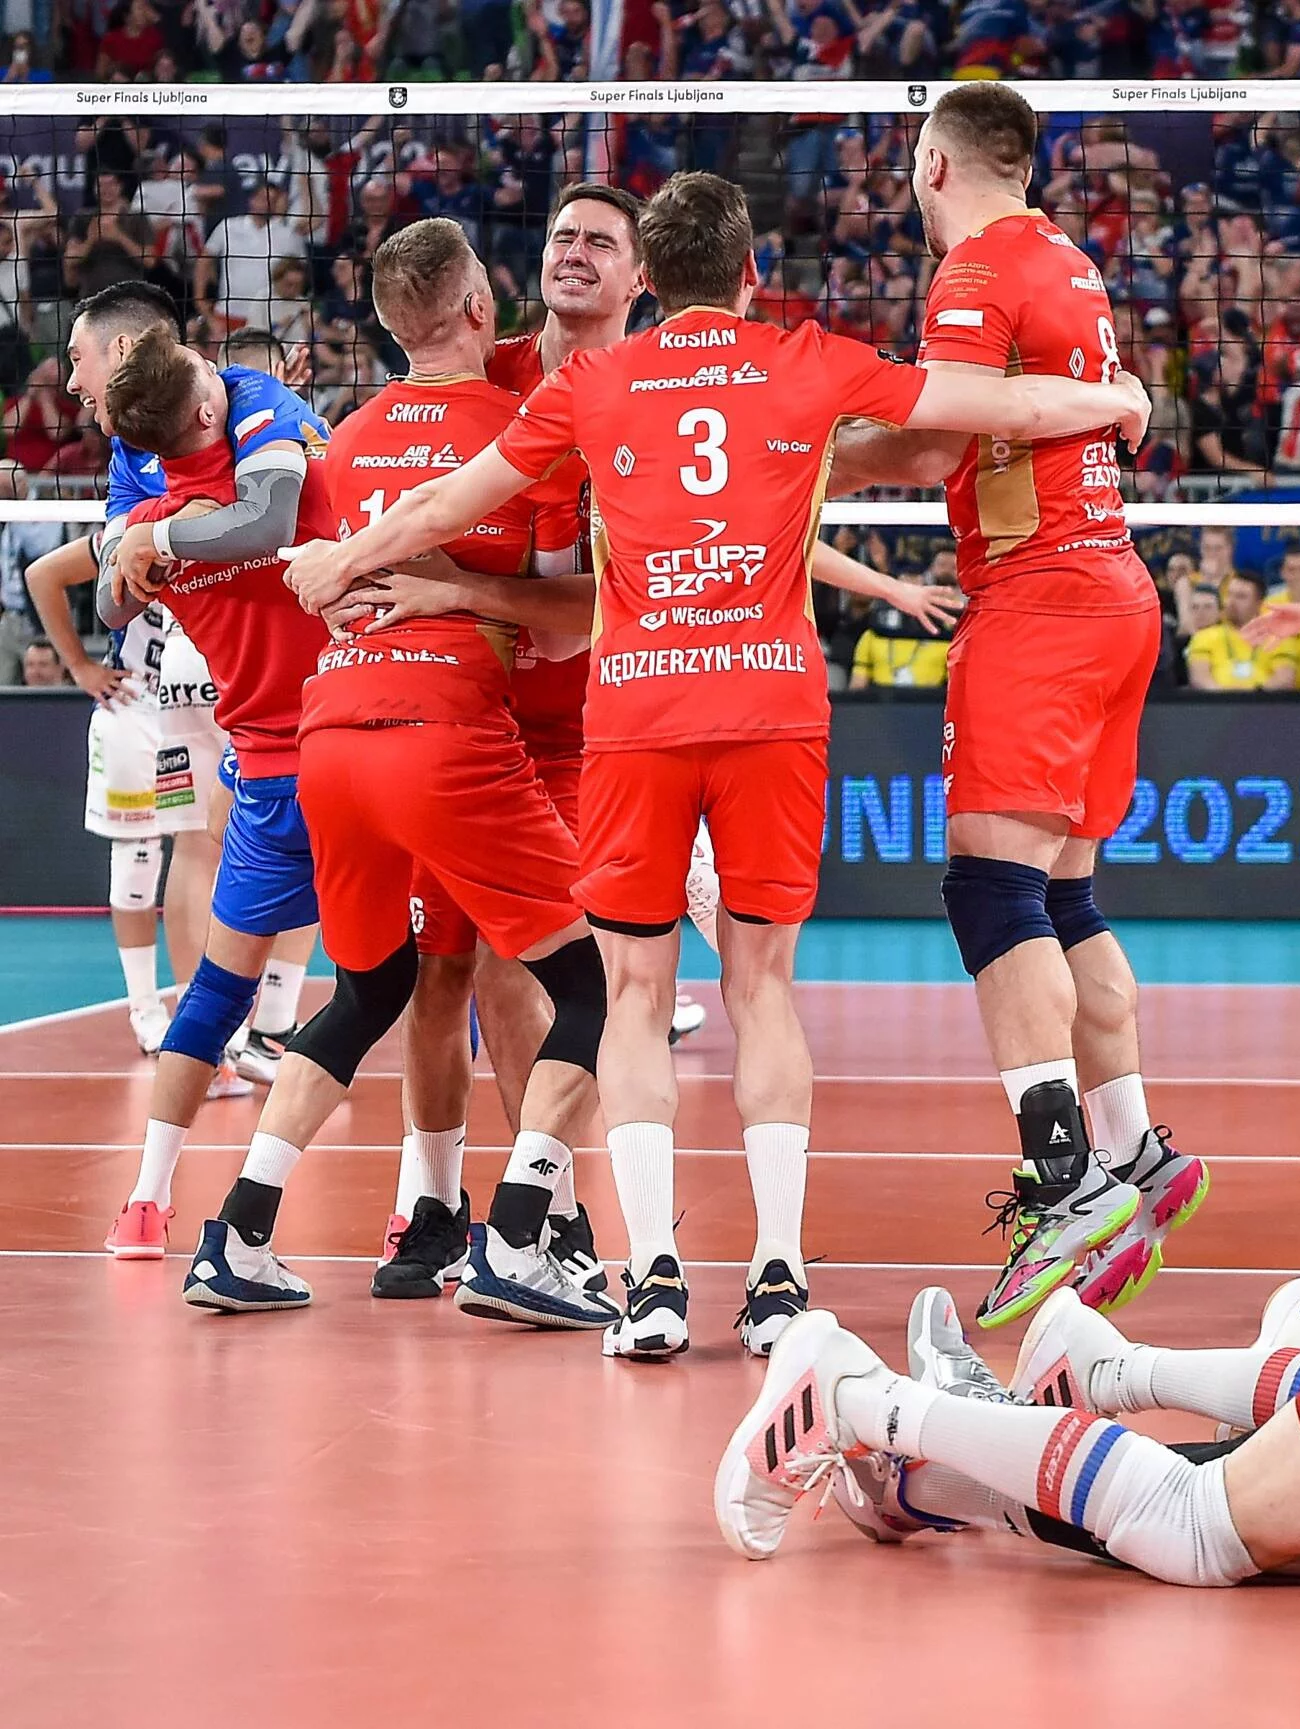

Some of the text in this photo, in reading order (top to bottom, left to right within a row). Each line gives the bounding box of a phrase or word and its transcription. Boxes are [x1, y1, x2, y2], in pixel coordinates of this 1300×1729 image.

[77, 92, 207, 105] Super Finals Ljubljana
[591, 89, 723, 103] Super Finals Ljubljana
[1113, 88, 1246, 101] Super Finals Ljubljana
[694, 365, 729, 377] AIR
[629, 374, 729, 394] PRODUCTS
[385, 402, 448, 423] SMITH
[402, 444, 432, 457] AIR
[676, 407, 730, 496] 3
[351, 455, 429, 469] PRODUCTS
[671, 603, 764, 627] WĘGLOKOKS
[598, 637, 807, 689] KĘDZIERZYN-KOŹLE
